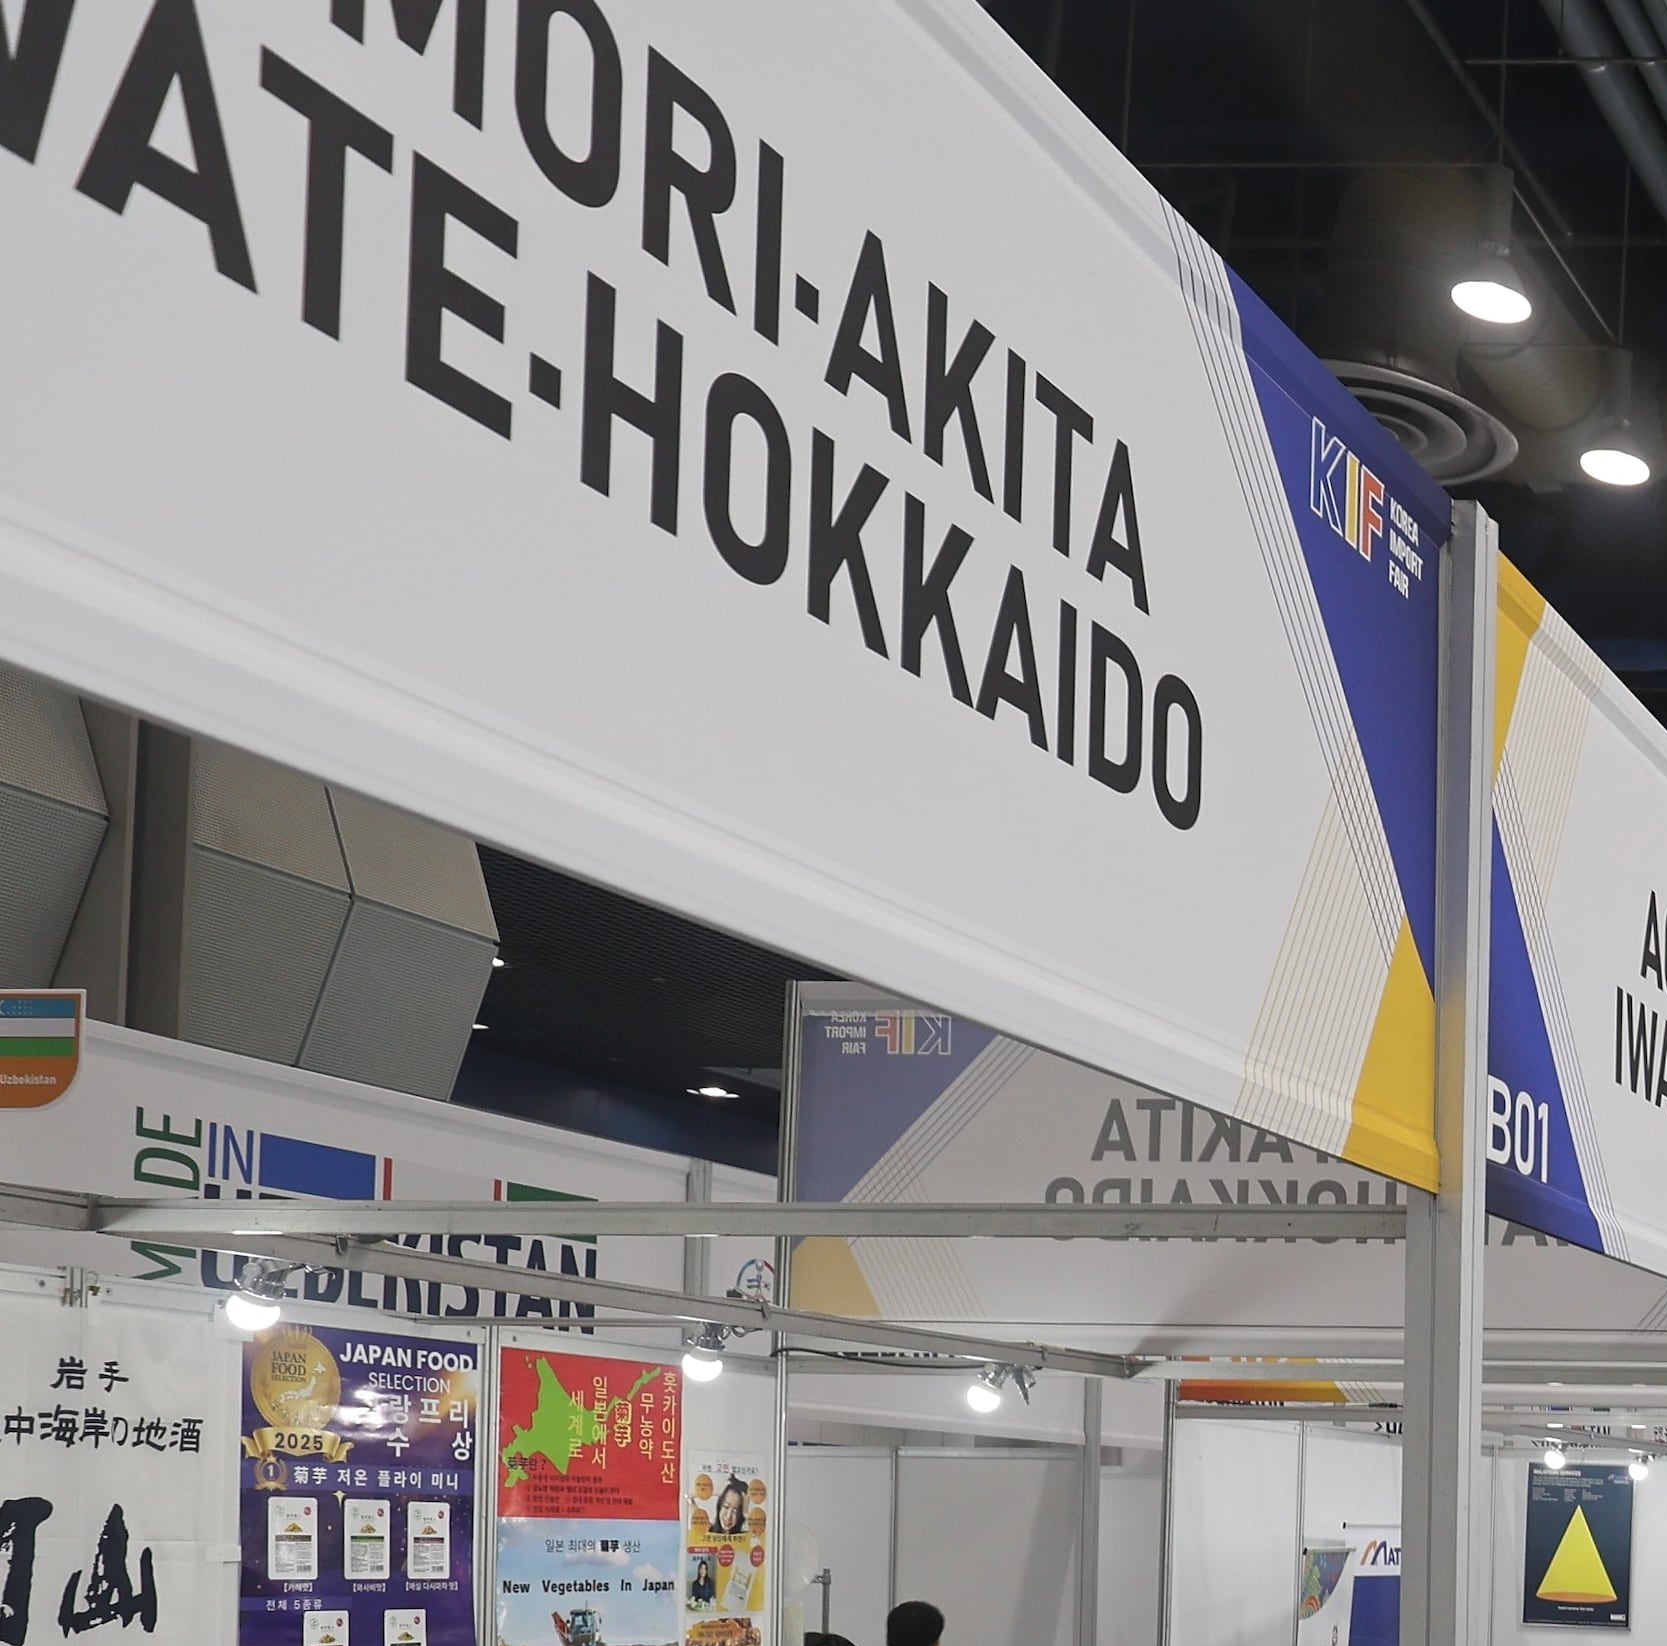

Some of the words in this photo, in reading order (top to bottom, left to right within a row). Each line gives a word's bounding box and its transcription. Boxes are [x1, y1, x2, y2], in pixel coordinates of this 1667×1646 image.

[1310, 416, 1385, 562] KIF
[1389, 497, 1419, 547] KOREA
[1389, 528, 1424, 581] IMPORT
[1388, 559, 1408, 599] FAIR
[207, 1121, 255, 1185] IN
[50, 1356, 129, 1392] 岩手
[271, 1363, 307, 1376] FOOD
[272, 1351, 307, 1364] JAPAN
[339, 1342, 412, 1368] JAPAN
[416, 1350, 473, 1372] FOOD
[368, 1372, 451, 1394] SELECTION
[0, 1404, 204, 1453] 中海岸の地酒
[274, 1432, 323, 1450] 2025
[568, 1391, 585, 1459] 세계로
[639, 1393, 655, 1460] 무농약
[662, 1371, 678, 1484] 홋카이도산
[294, 1466, 328, 1485] 菊芋
[337, 1469, 368, 1487] 저온
[377, 1470, 422, 1488] 플라이
[431, 1472, 459, 1490] 미니
[545, 1539, 564, 1552] 일본
[568, 1539, 596, 1553] 최대의
[623, 1539, 641, 1553] 생산
[502, 1580, 530, 1594] New
[541, 1579, 611, 1595] Vegetables
[620, 1579, 632, 1592] In
[642, 1577, 675, 1594] Japan
[265, 1599, 288, 1611] 전체
